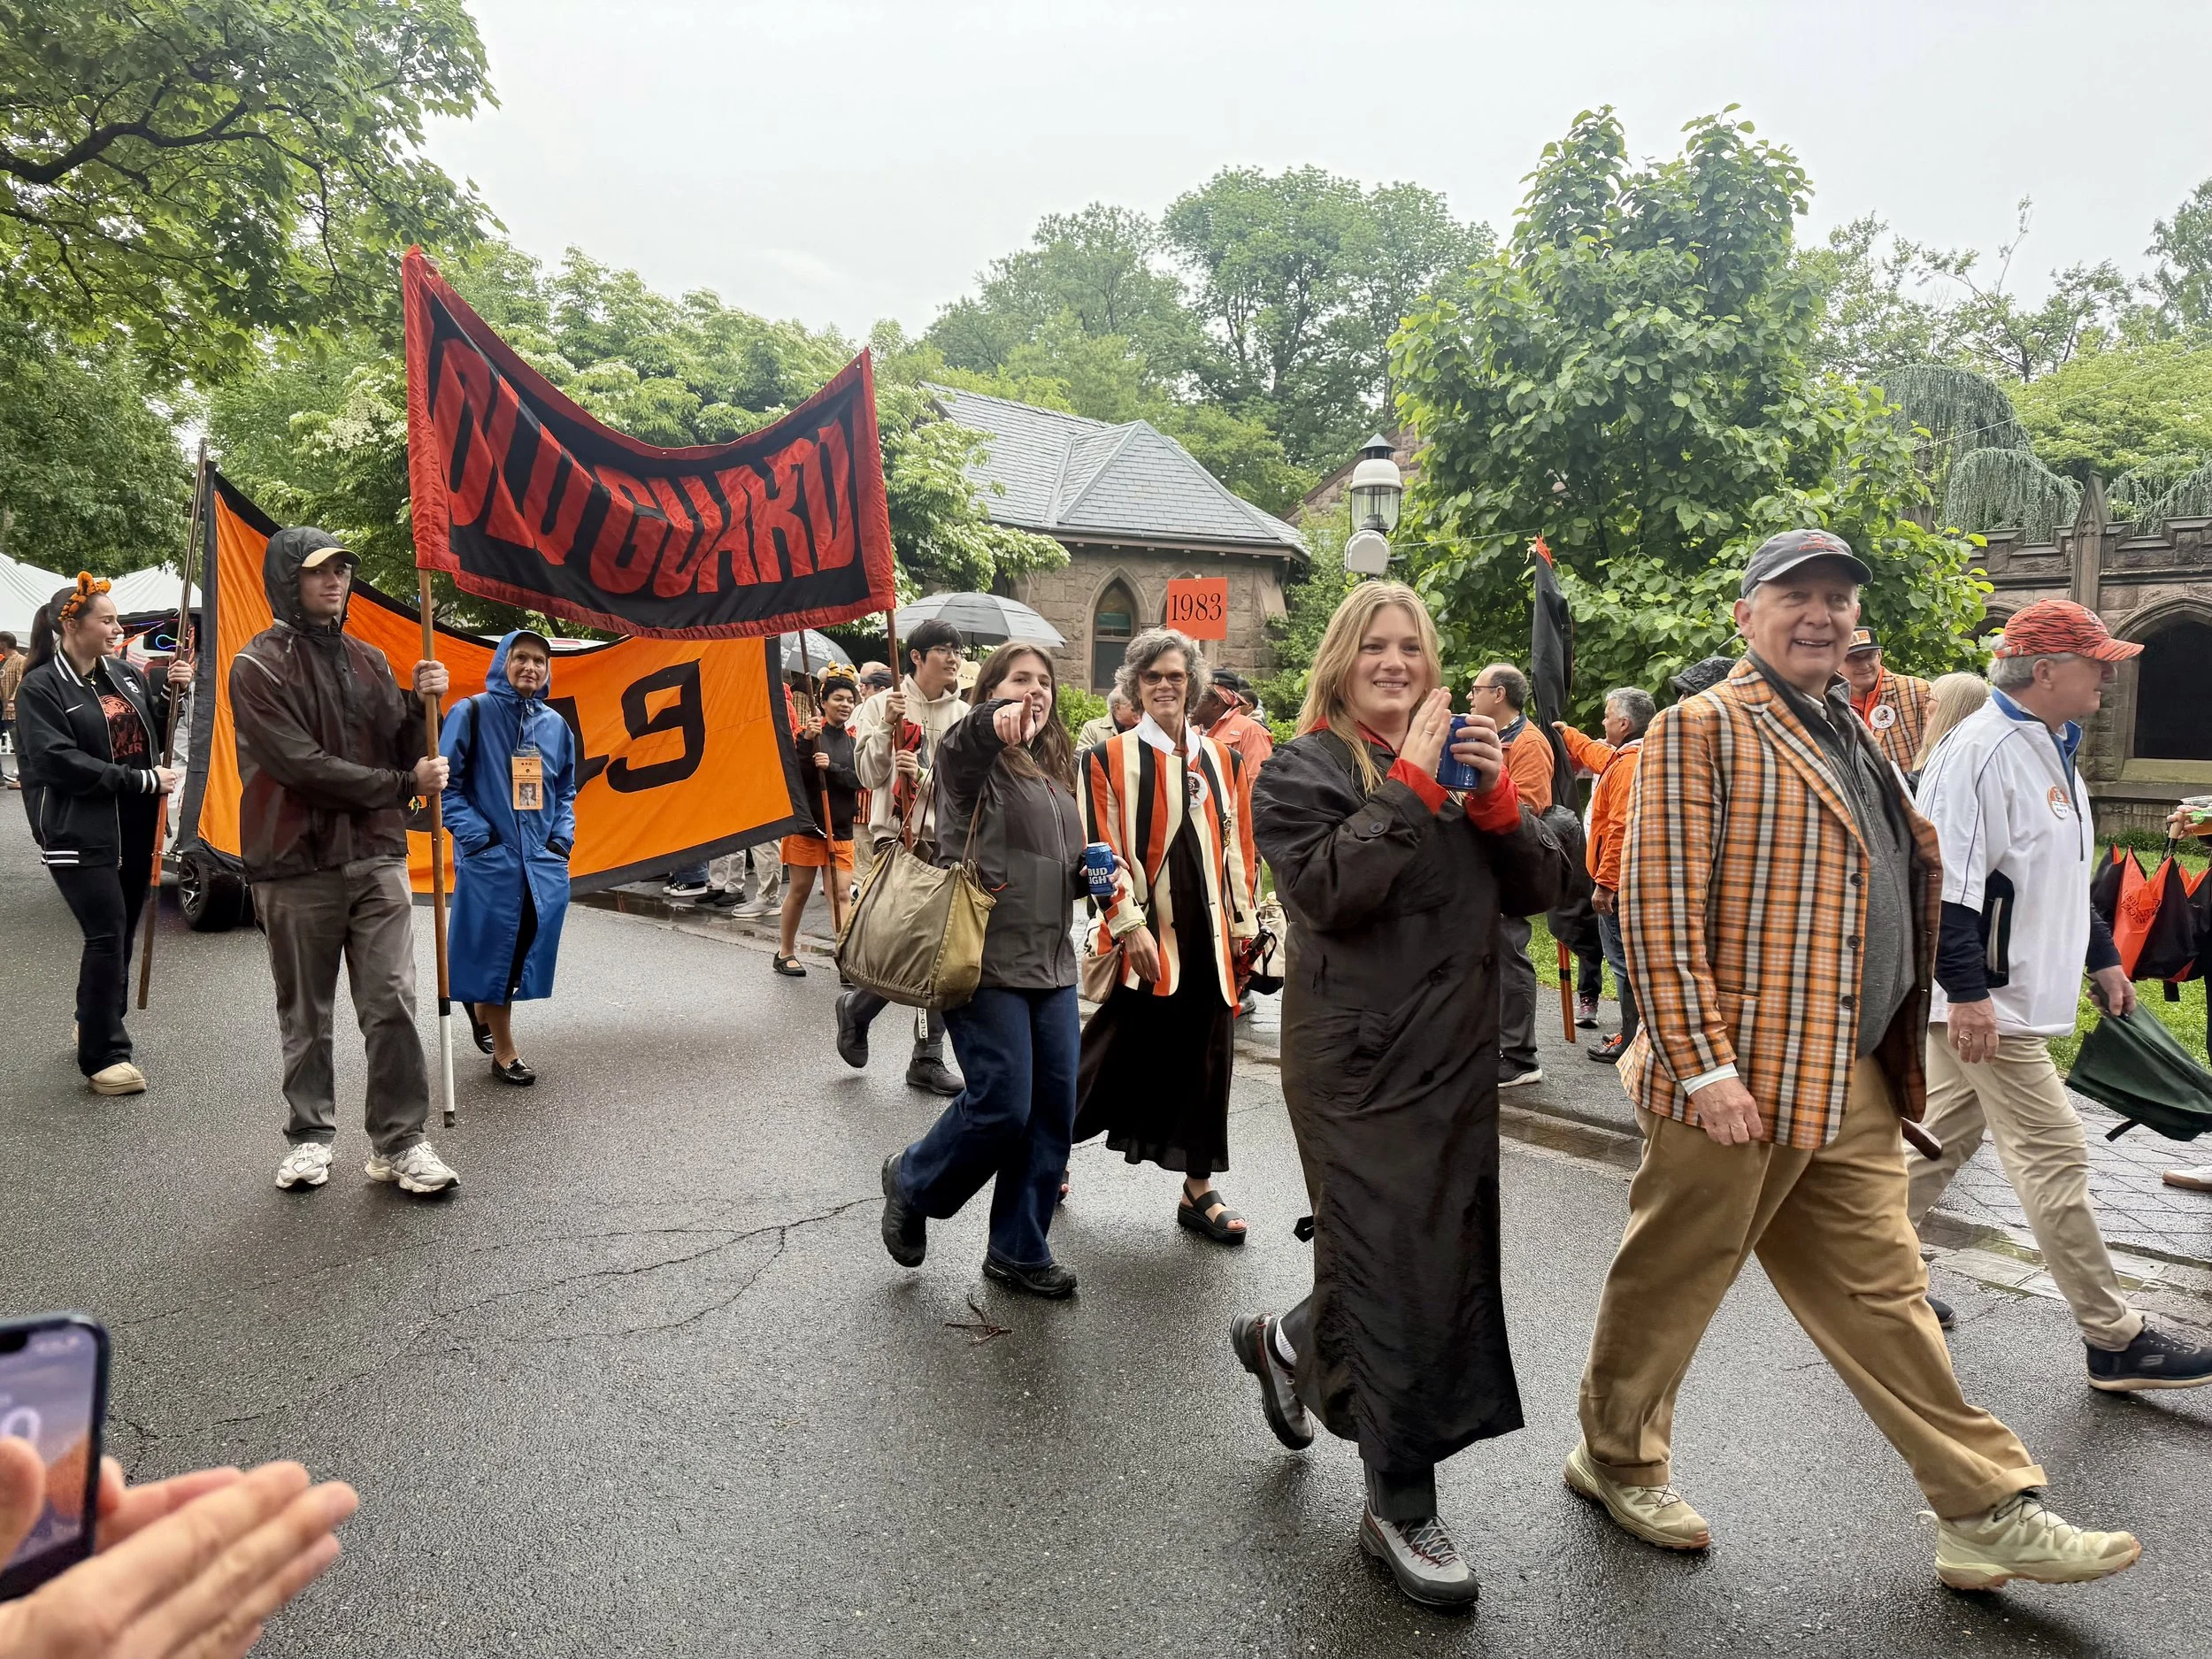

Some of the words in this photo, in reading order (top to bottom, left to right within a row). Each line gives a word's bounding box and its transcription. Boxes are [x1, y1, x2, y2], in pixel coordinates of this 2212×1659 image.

[588, 420, 856, 598] GUARD
[1171, 593, 1222, 621] 1983
[1087, 867, 1108, 876] BUD
[1088, 876, 1107, 885] IGH
